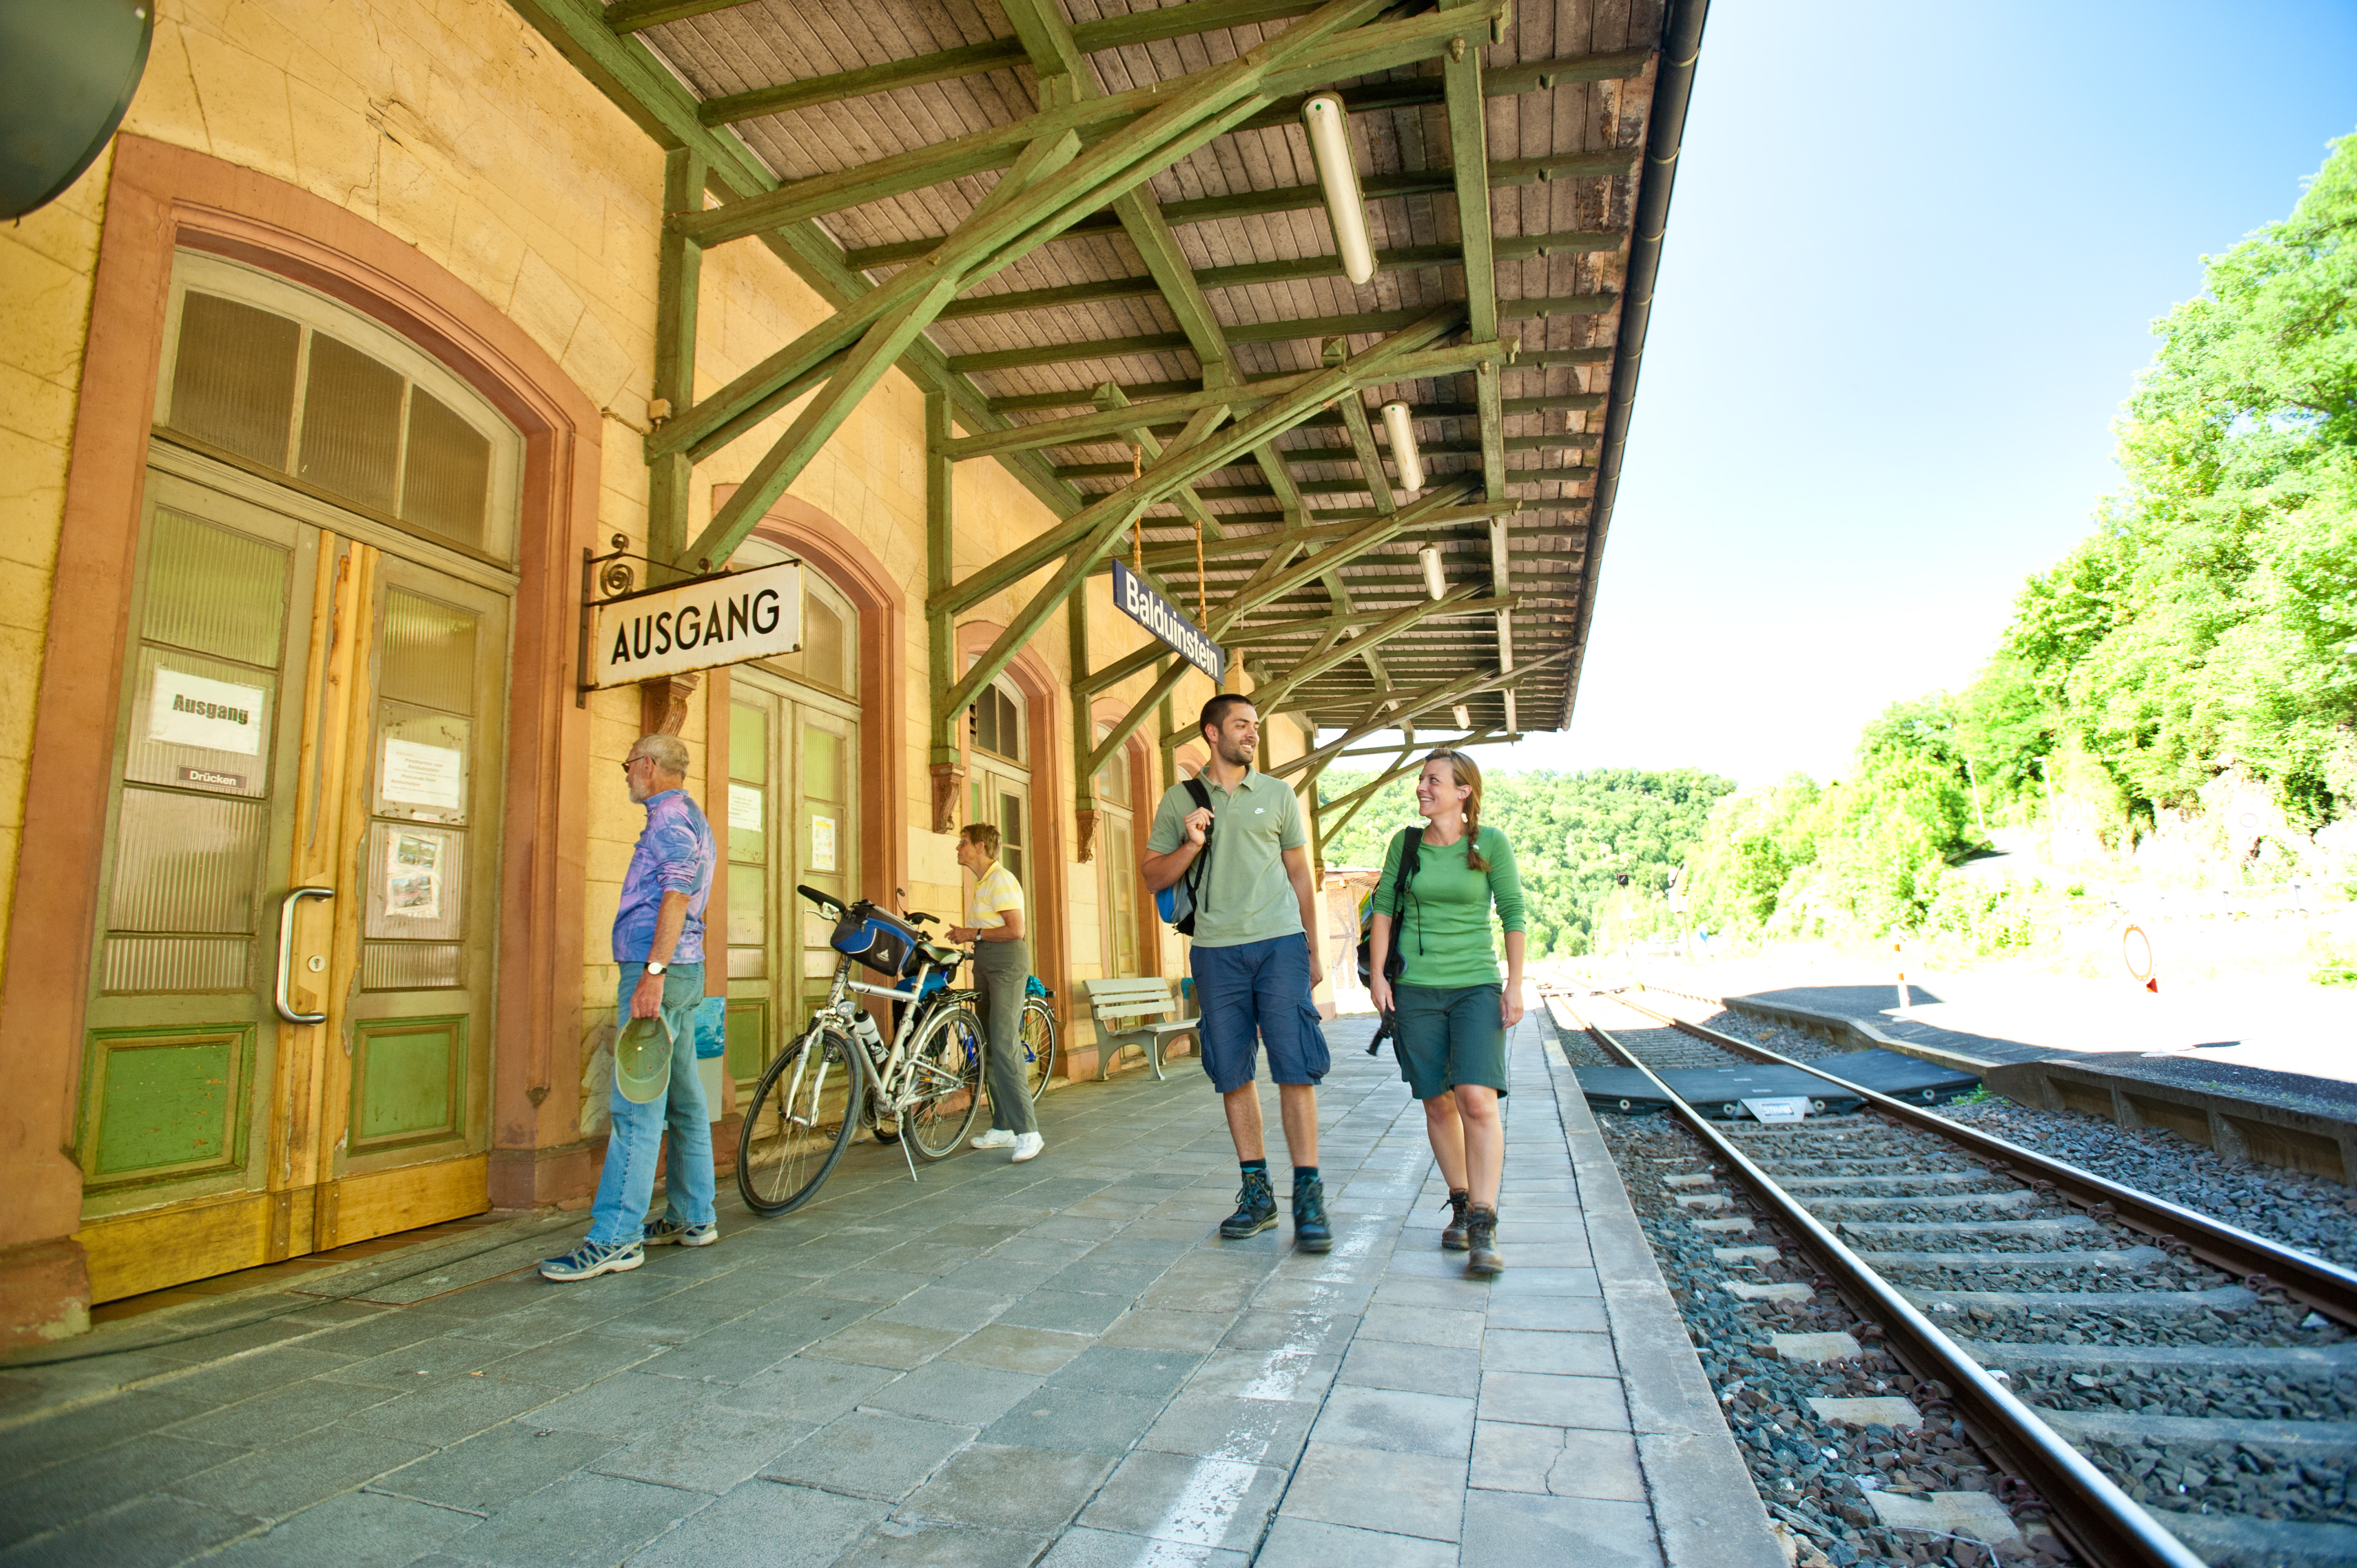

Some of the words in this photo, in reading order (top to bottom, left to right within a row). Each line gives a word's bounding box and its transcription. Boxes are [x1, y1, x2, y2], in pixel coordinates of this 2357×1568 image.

[611, 589, 780, 665] AUSGANG
[1126, 571, 1218, 677] Balduinstein
[172, 694, 249, 725] Ausgang
[189, 770, 237, 786] Drücken
